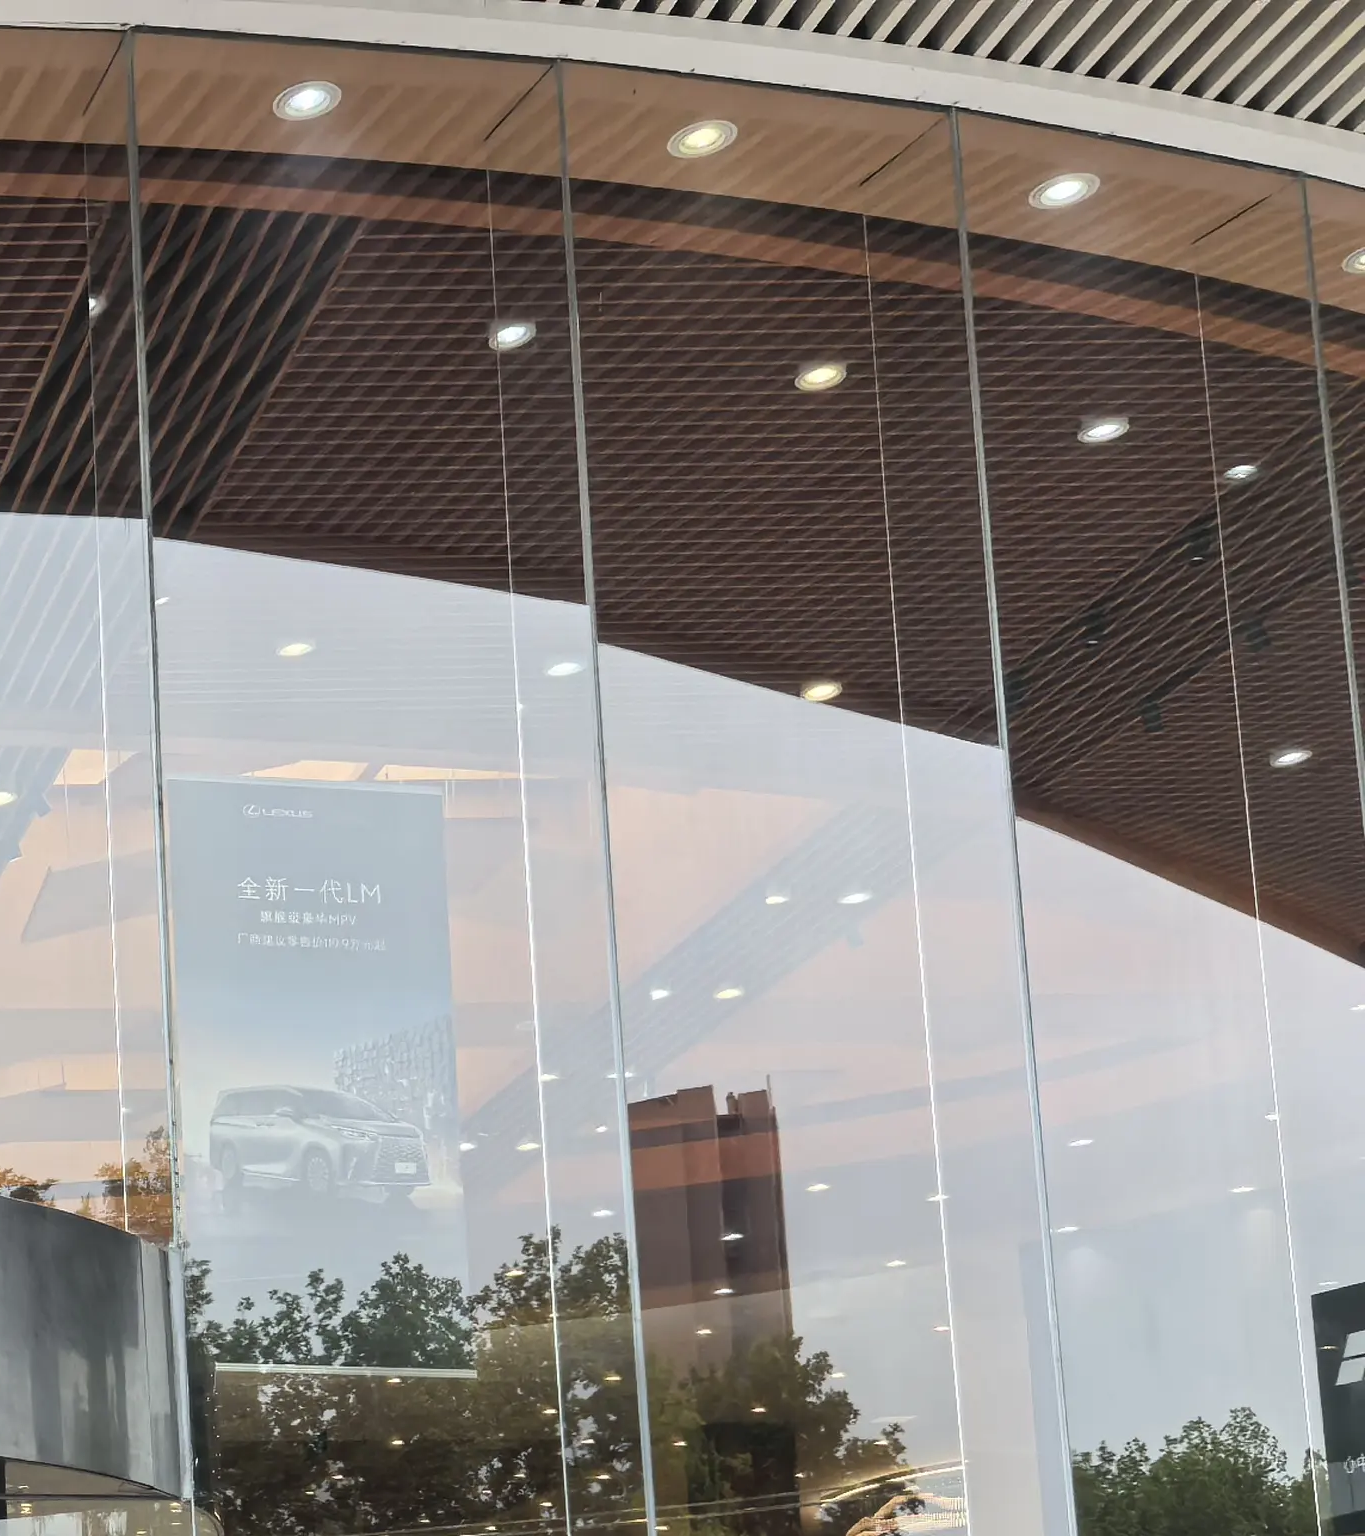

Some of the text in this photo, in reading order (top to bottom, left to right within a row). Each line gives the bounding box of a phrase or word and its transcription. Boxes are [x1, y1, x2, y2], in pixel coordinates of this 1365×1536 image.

[262, 808, 313, 818] LEXUS
[237, 876, 382, 904] 全新一代LM
